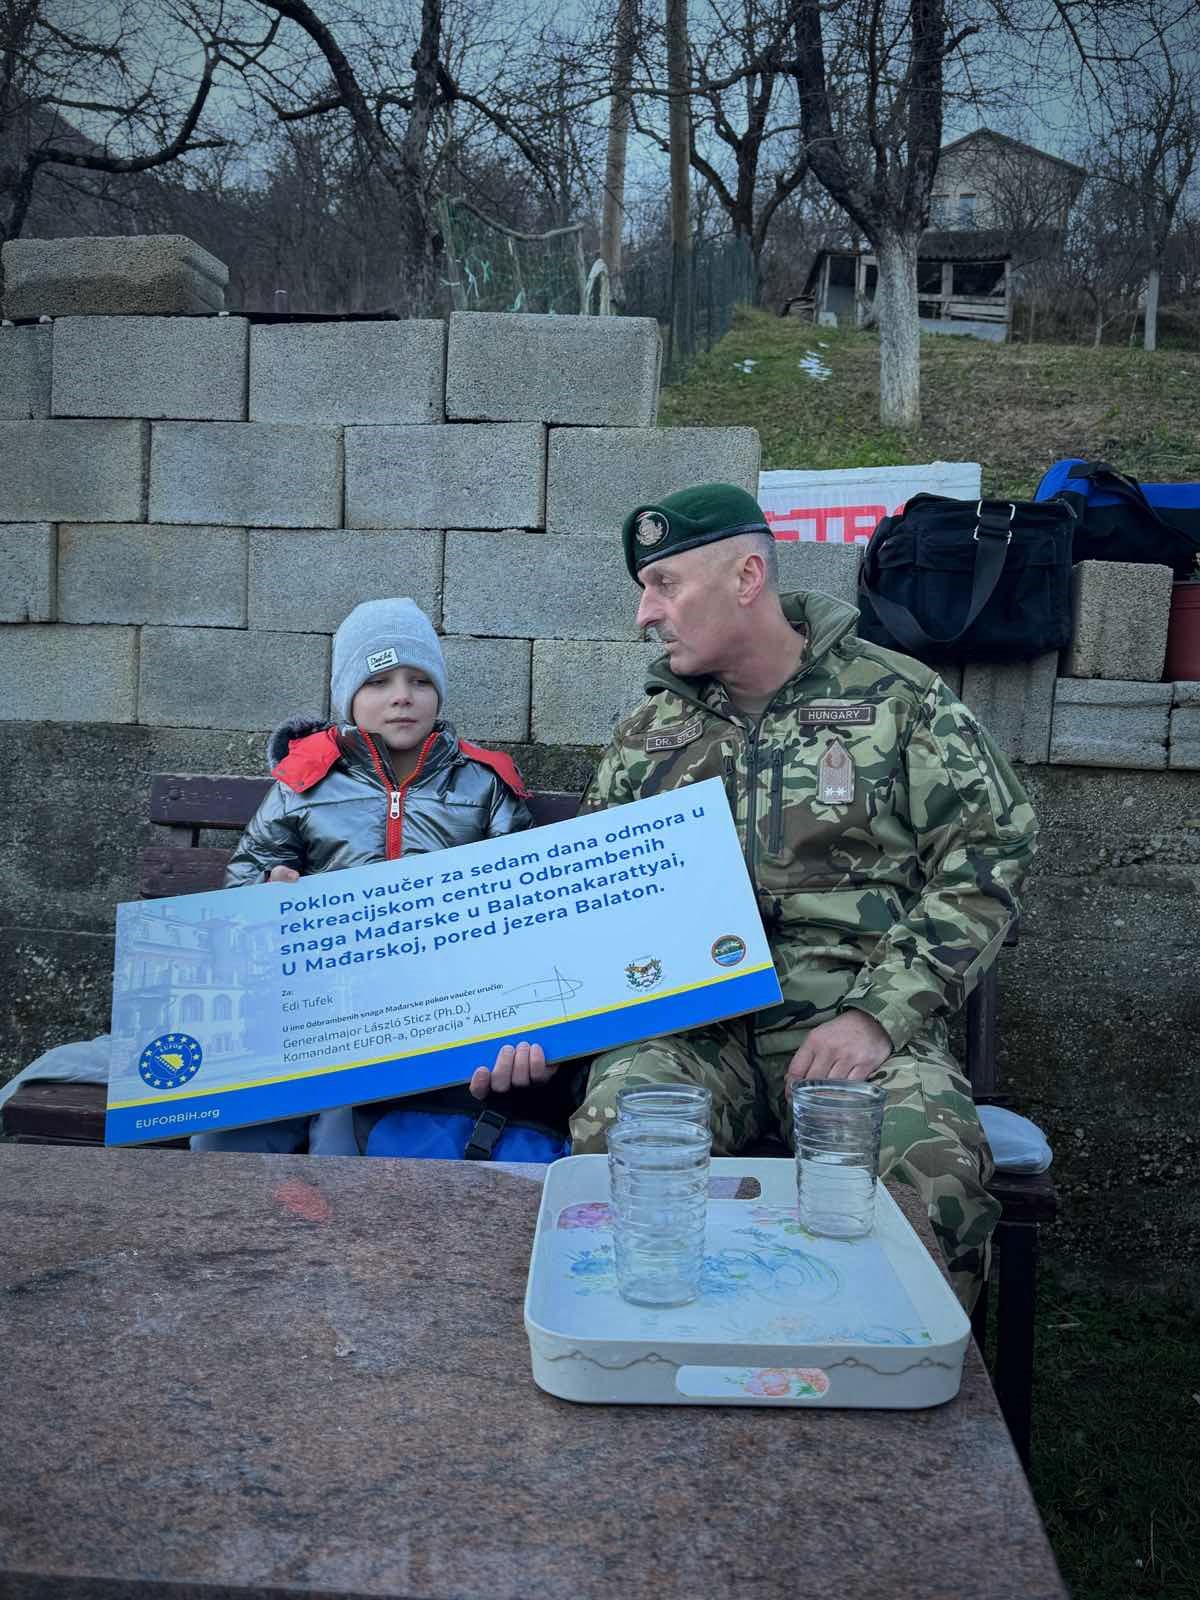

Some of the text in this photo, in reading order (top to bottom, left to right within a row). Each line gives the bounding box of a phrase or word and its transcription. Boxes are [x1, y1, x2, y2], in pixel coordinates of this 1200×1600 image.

[807, 710, 860, 721] HUNGARY
[280, 805, 705, 915] Poklon vaučer za sedam dana odmora u
[280, 837, 665, 935] rekreacijskom centru Odbrambenih
[280, 852, 685, 956] snaga Mađarske u Balatonakarattyai,
[281, 883, 665, 976] U Mađarskoj, pored jezera Balaton.
[282, 995, 334, 1012] Edi Tufek
[282, 1025, 289, 1033] U
[306, 1012, 359, 1029] Odbrambenih
[360, 1008, 384, 1018] snaga
[282, 1001, 471, 1049] Generalmajor László Sticz (Ph.D.)
[283, 1043, 350, 1063] Komandant
[353, 1033, 408, 1049] EUFOR-a,
[410, 1019, 464, 1038] Operacija
